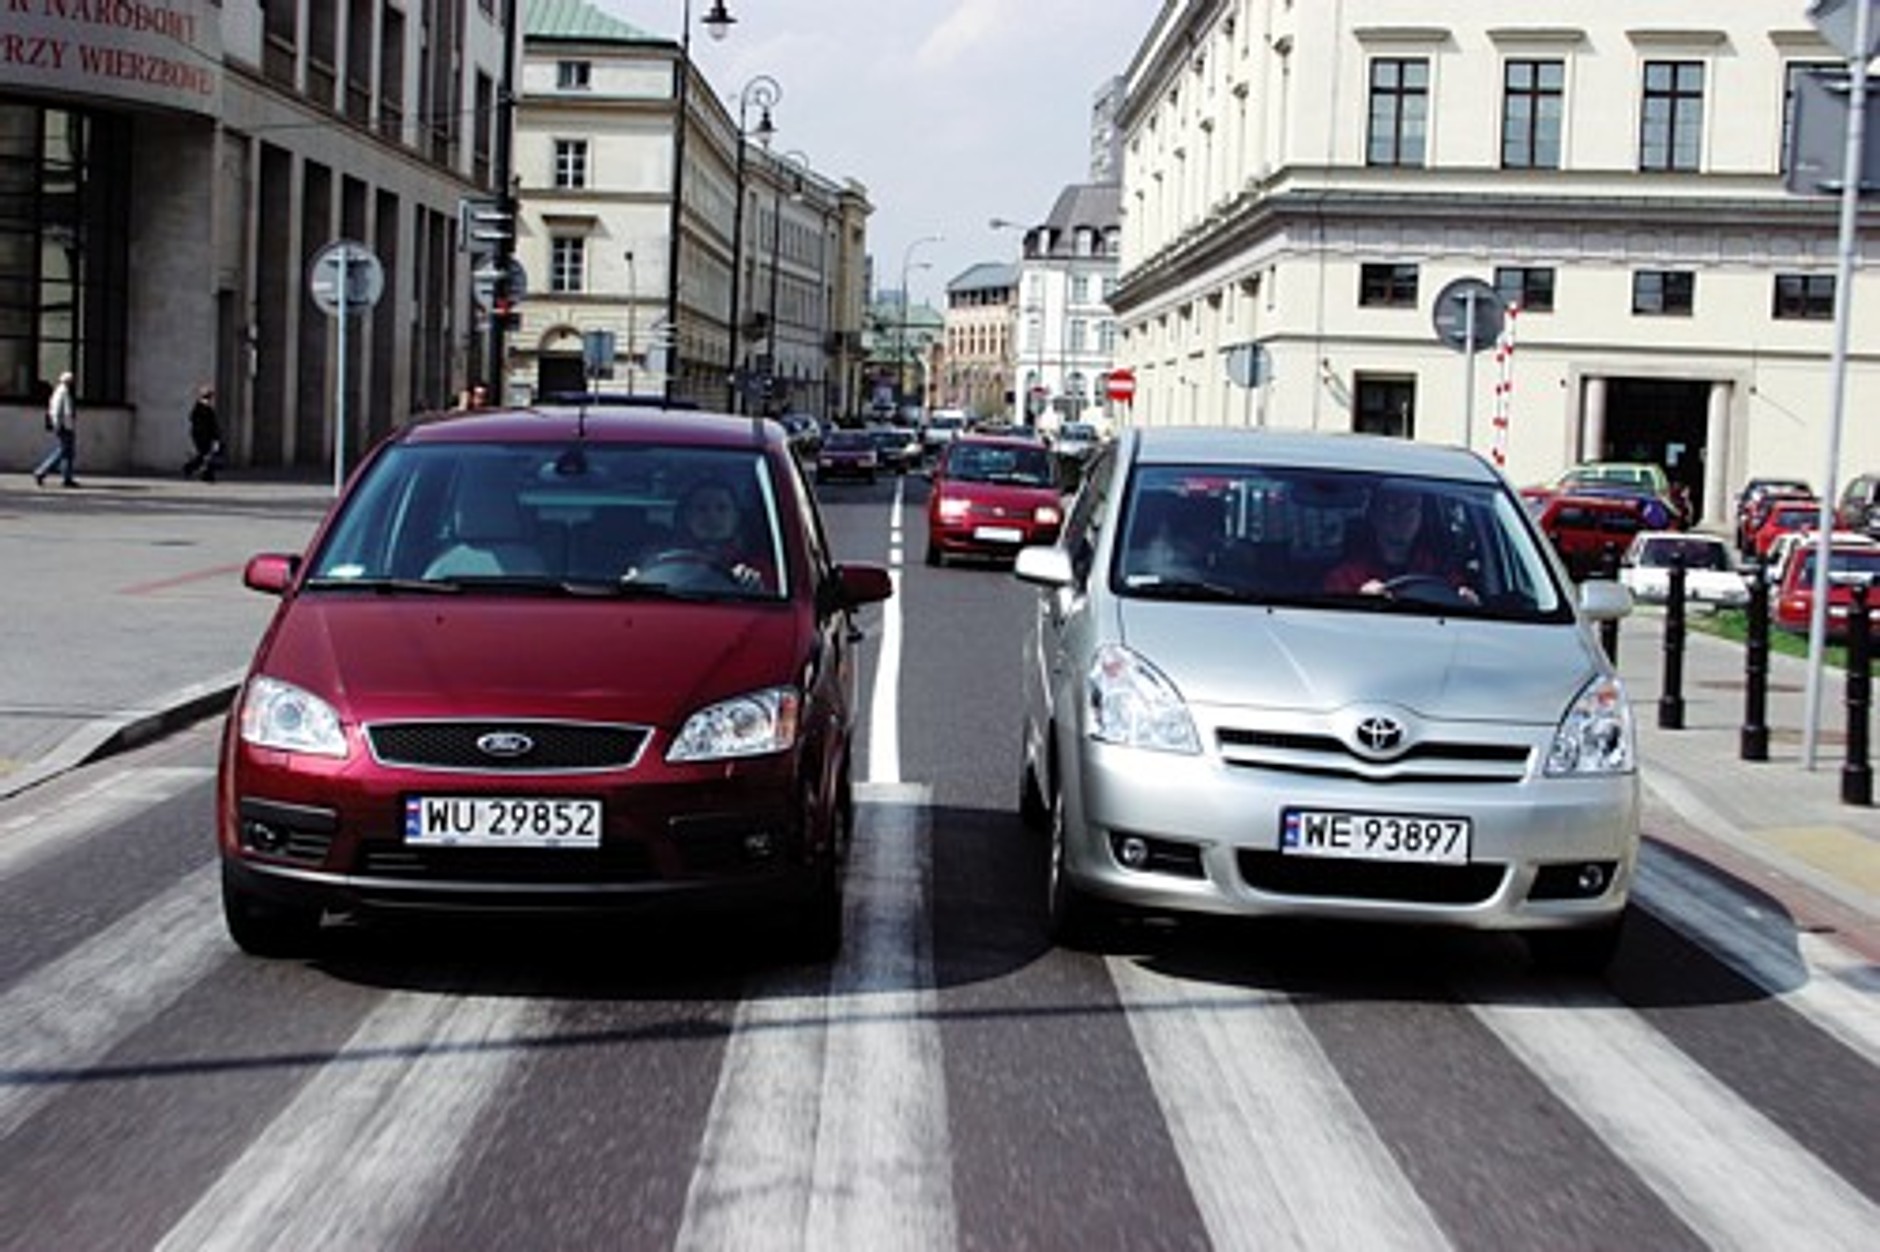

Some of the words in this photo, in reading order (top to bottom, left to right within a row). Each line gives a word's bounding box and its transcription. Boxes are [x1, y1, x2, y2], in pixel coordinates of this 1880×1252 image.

[0, 33, 70, 69] RZY
[427, 801, 476, 833] WU
[488, 803, 596, 836] 29852
[1304, 815, 1351, 847] WE
[1364, 819, 1463, 854] 93897
